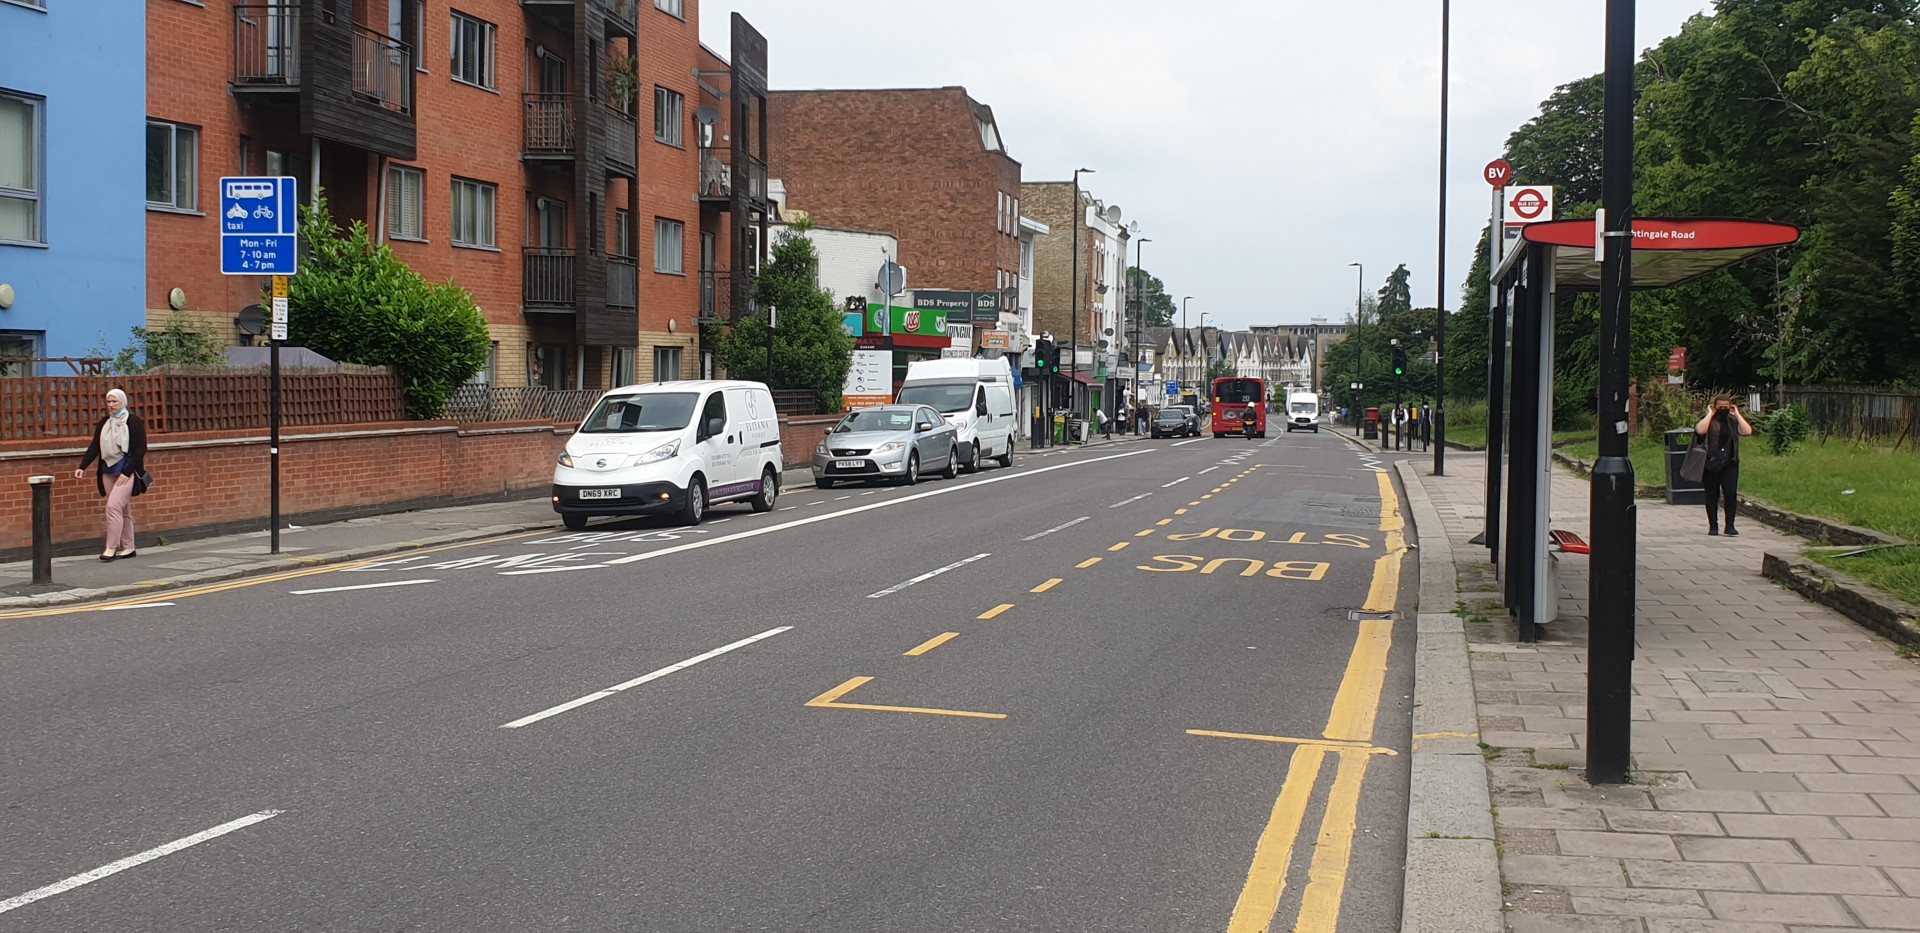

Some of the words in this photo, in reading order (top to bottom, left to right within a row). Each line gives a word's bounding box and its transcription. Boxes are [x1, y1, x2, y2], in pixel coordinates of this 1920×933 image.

[1489, 167, 1506, 179] BV
[227, 221, 244, 230] taxi
[1631, 229, 1669, 240] htingale
[1671, 230, 1695, 239] Road
[240, 238, 259, 248] Mon
[265, 238, 277, 248] Fri
[261, 262, 275, 271] pm
[917, 299, 935, 307] BDS
[936, 299, 969, 308] Property
[977, 300, 995, 308] BDS
[582, 490, 601, 498] DN69
[603, 489, 618, 497] XRC
[1166, 527, 1372, 549] STOP
[1136, 554, 1332, 581] BUS
